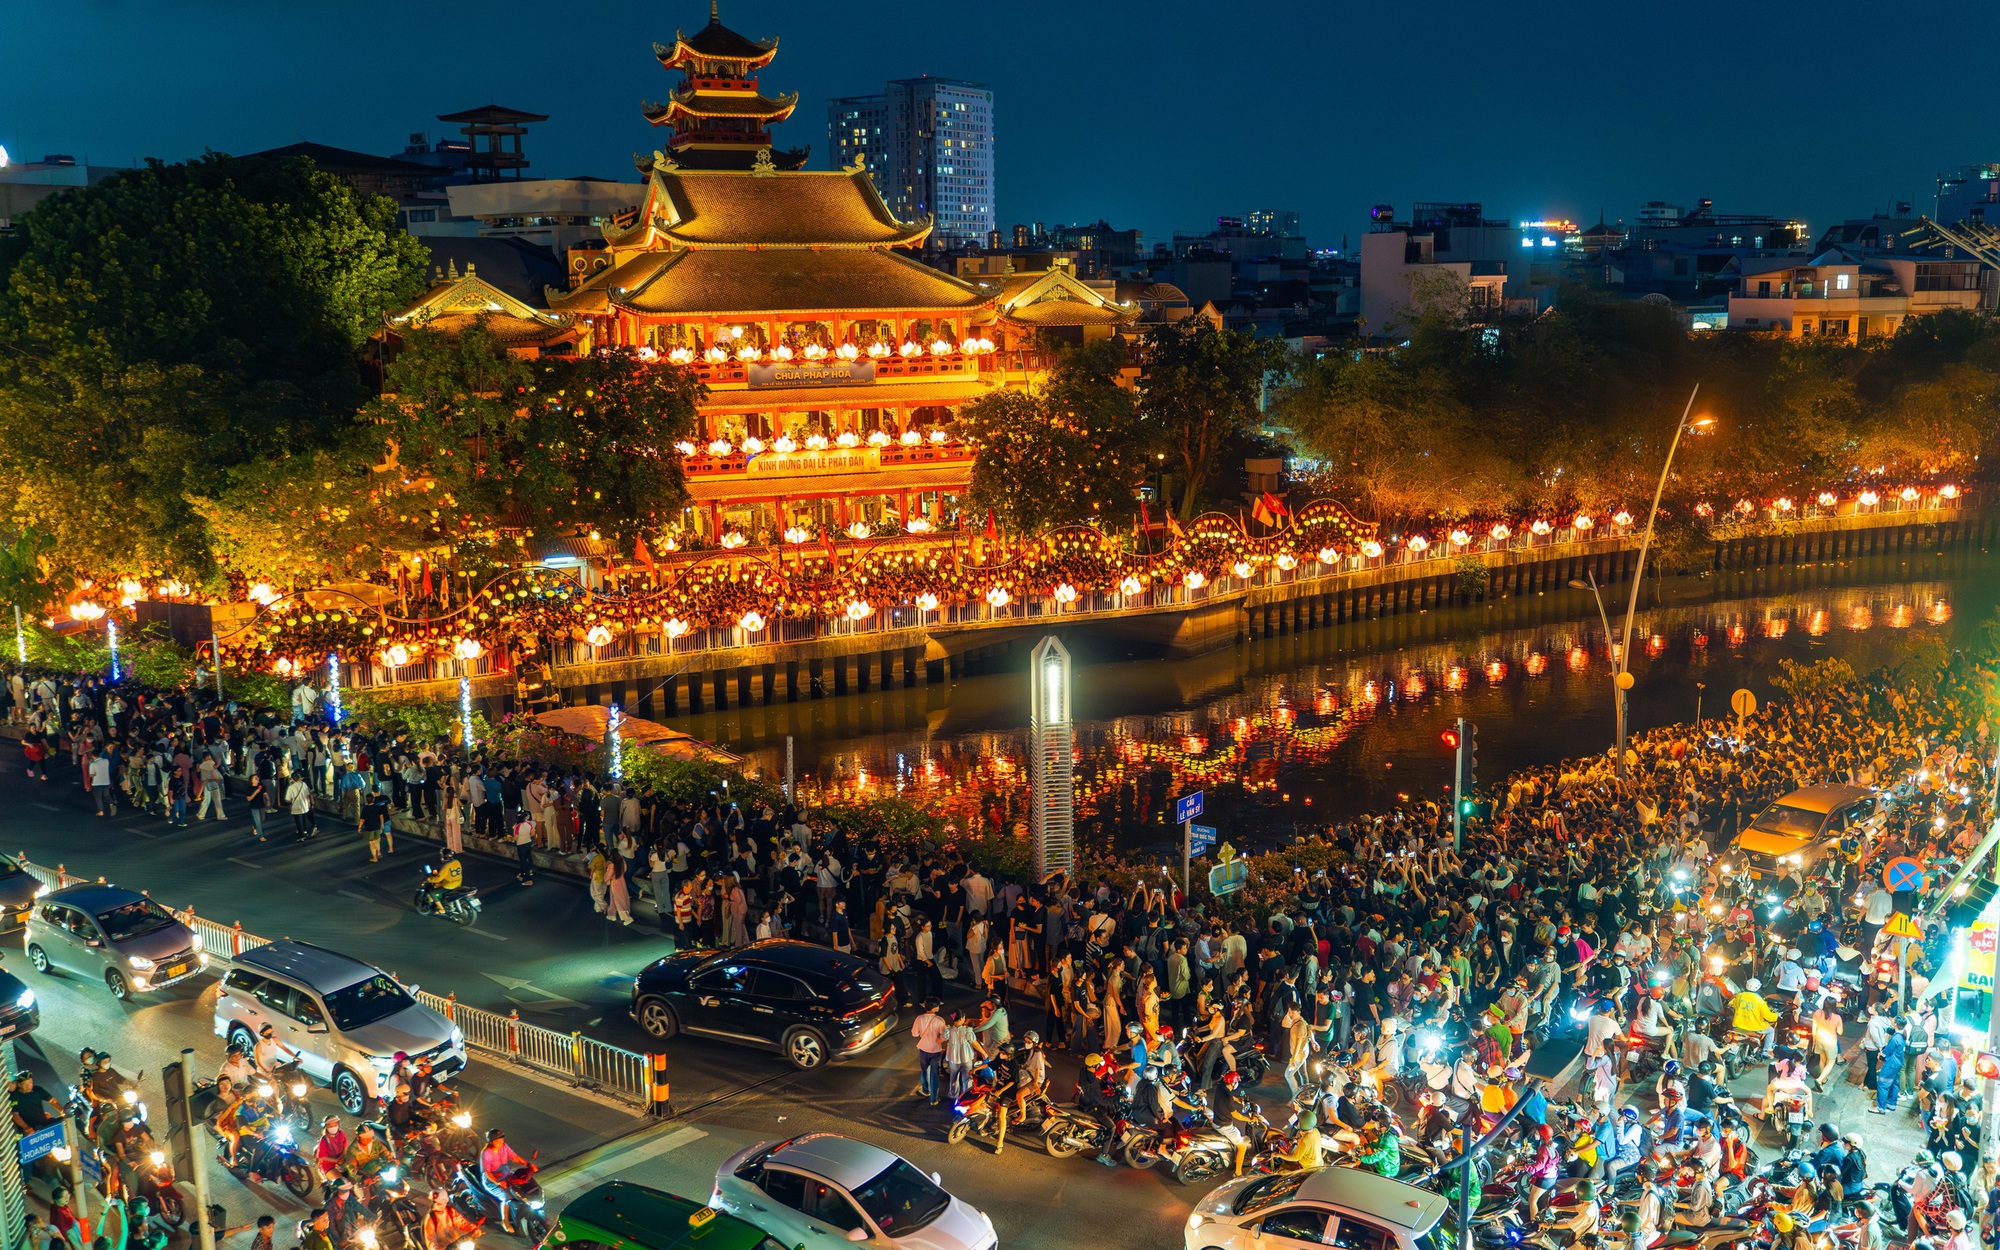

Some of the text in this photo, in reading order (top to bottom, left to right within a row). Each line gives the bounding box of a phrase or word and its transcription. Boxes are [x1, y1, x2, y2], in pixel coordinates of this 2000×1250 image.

[775, 368, 851, 380] CHÙA PHÁP HOA
[449, 867, 461, 878] be
[29, 1130, 55, 1145] ĐƯỜNG
[52, 1138, 63, 1148] SA
